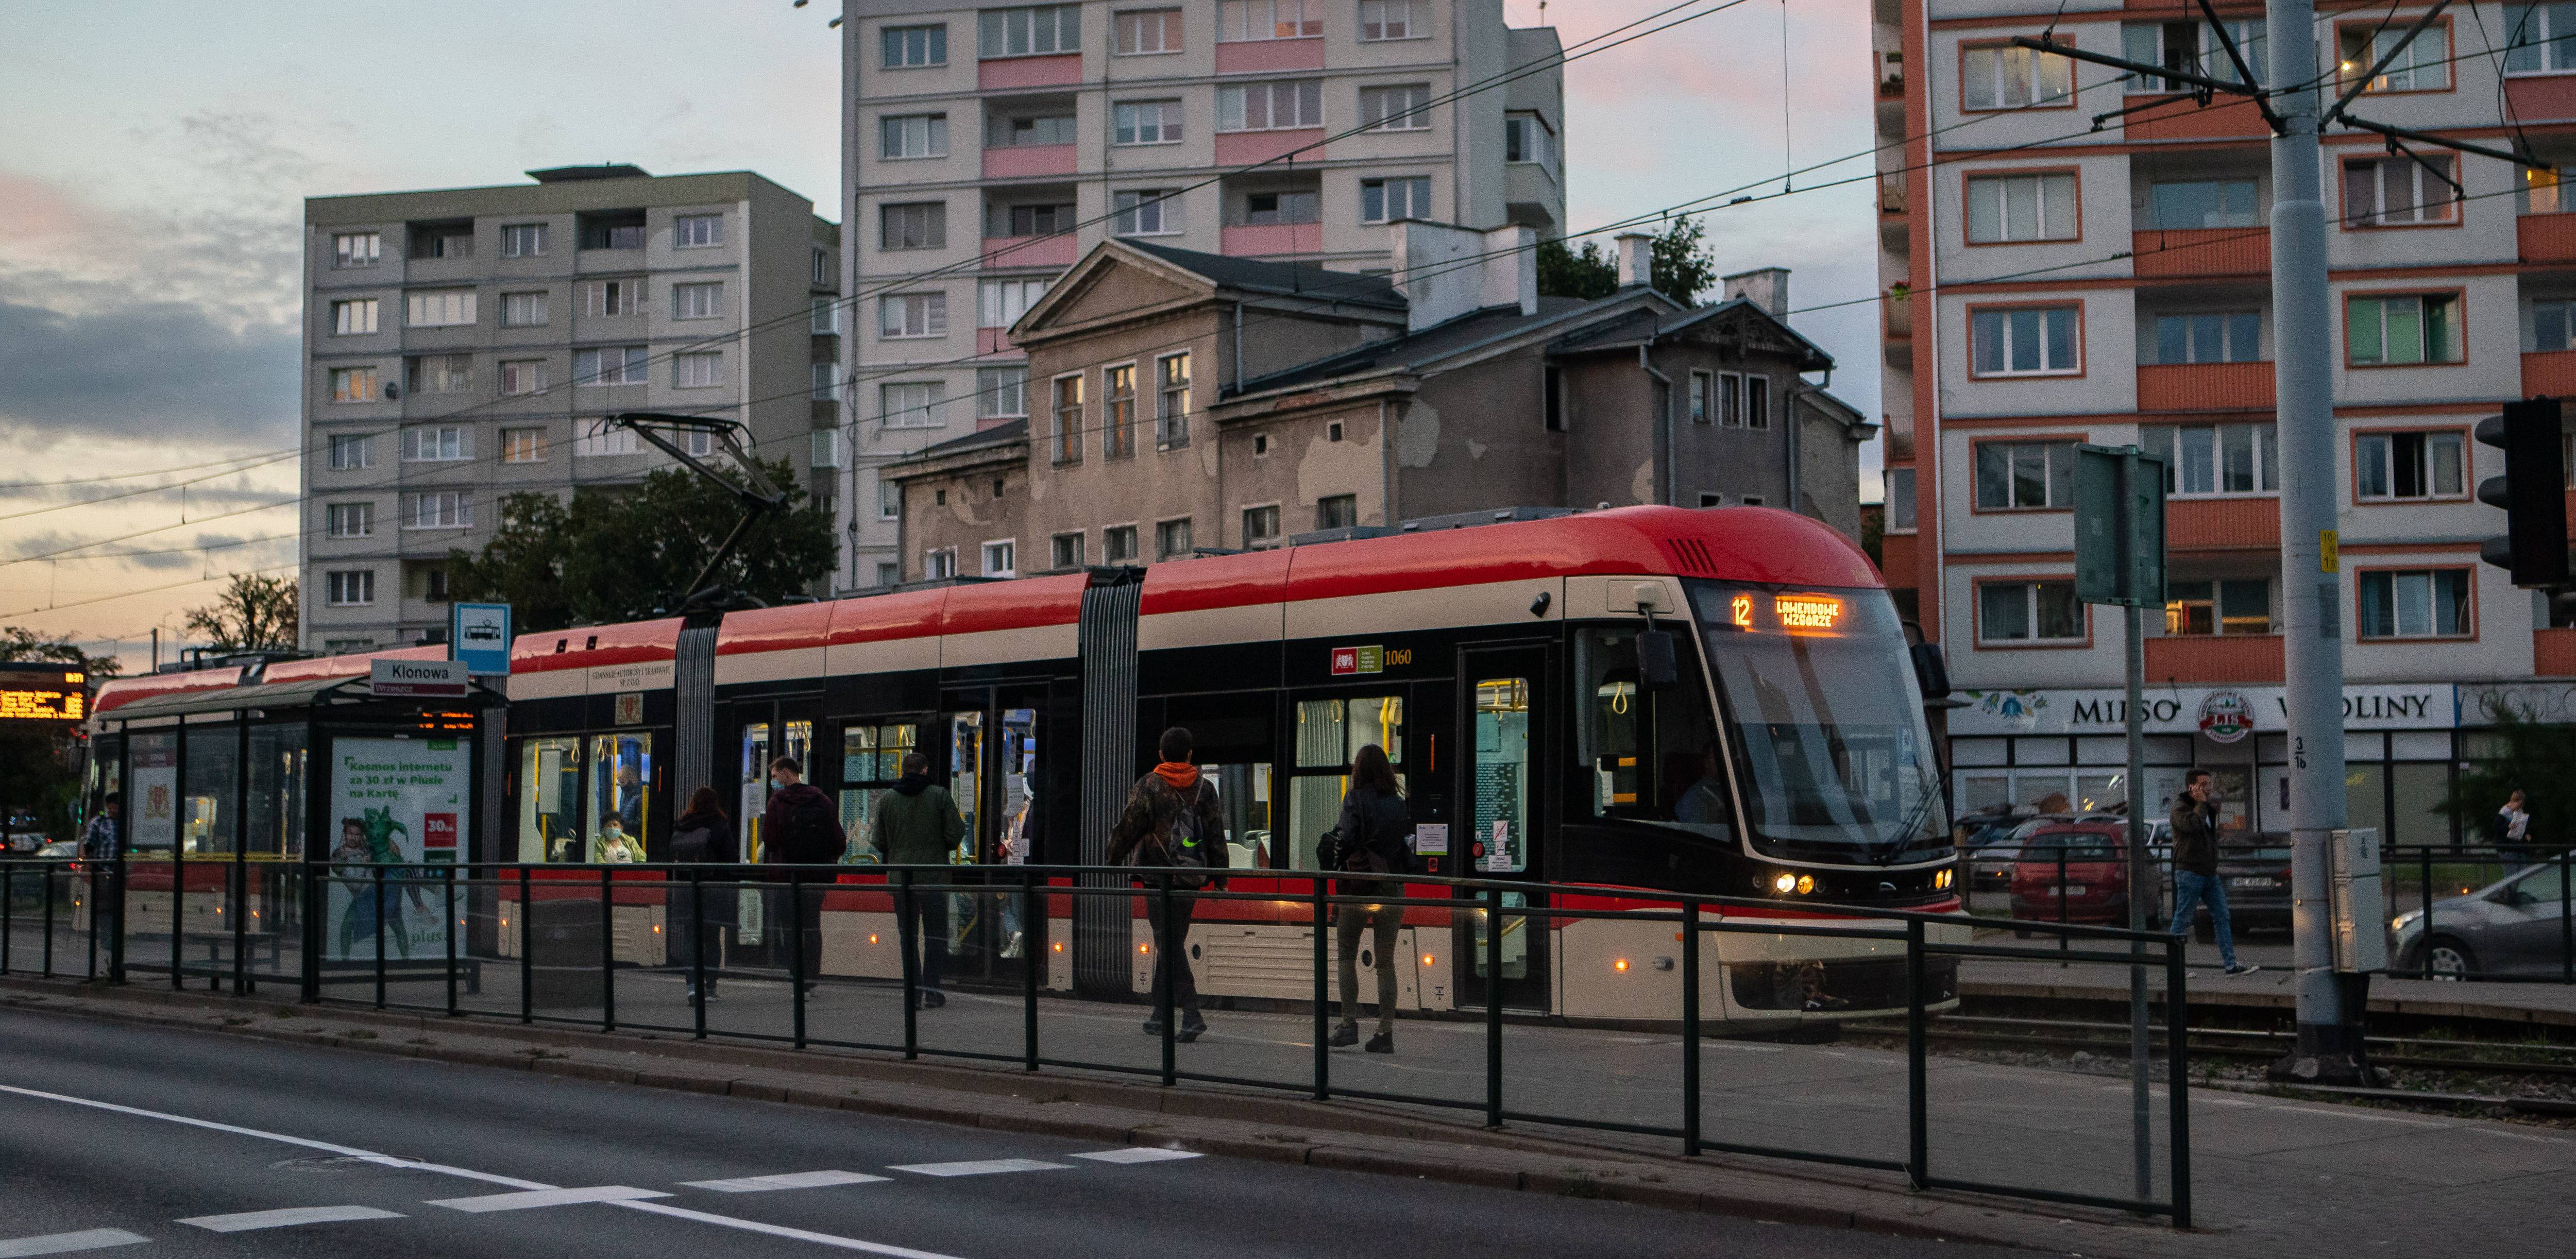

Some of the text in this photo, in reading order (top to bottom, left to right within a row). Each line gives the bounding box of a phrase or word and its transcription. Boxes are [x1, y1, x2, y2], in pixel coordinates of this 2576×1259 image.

[1732, 599, 1750, 625] 12
[1776, 601, 1838, 616] LAWENDOWE
[1784, 614, 1832, 627] WZGÓRZE
[1385, 649, 1412, 665] 1060
[393, 665, 448, 679] Klonowa
[2296, 736, 2303, 750] 3
[350, 762, 396, 771] Kosmos
[366, 776, 380, 785] 30
[383, 775, 394, 785] zł
[410, 775, 444, 785] Plusie
[366, 790, 399, 801] Kartę
[412, 929, 442, 946] plus
